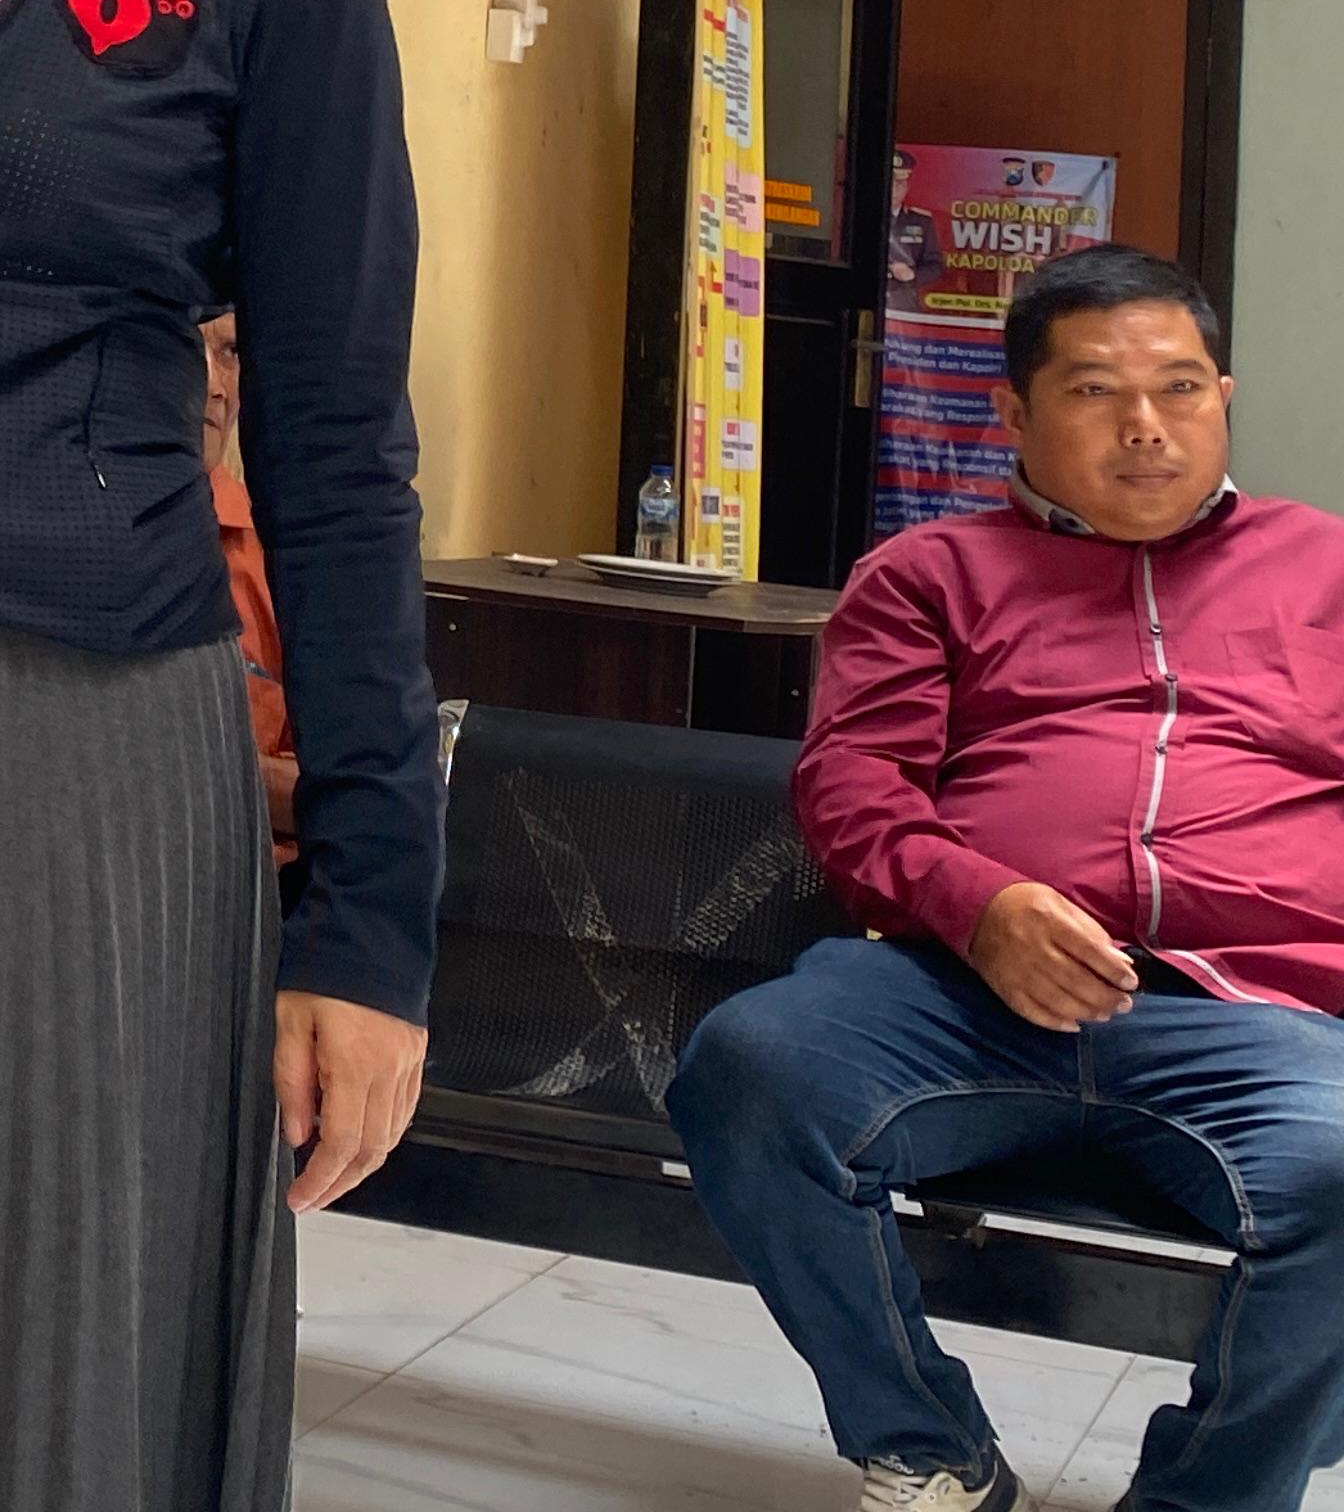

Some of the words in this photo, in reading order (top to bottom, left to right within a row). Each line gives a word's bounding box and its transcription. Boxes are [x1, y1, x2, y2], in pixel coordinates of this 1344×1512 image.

[951, 199, 1099, 226] COMMANDER
[951, 219, 1053, 254] WISH
[945, 251, 1035, 273] KAPOLDA
